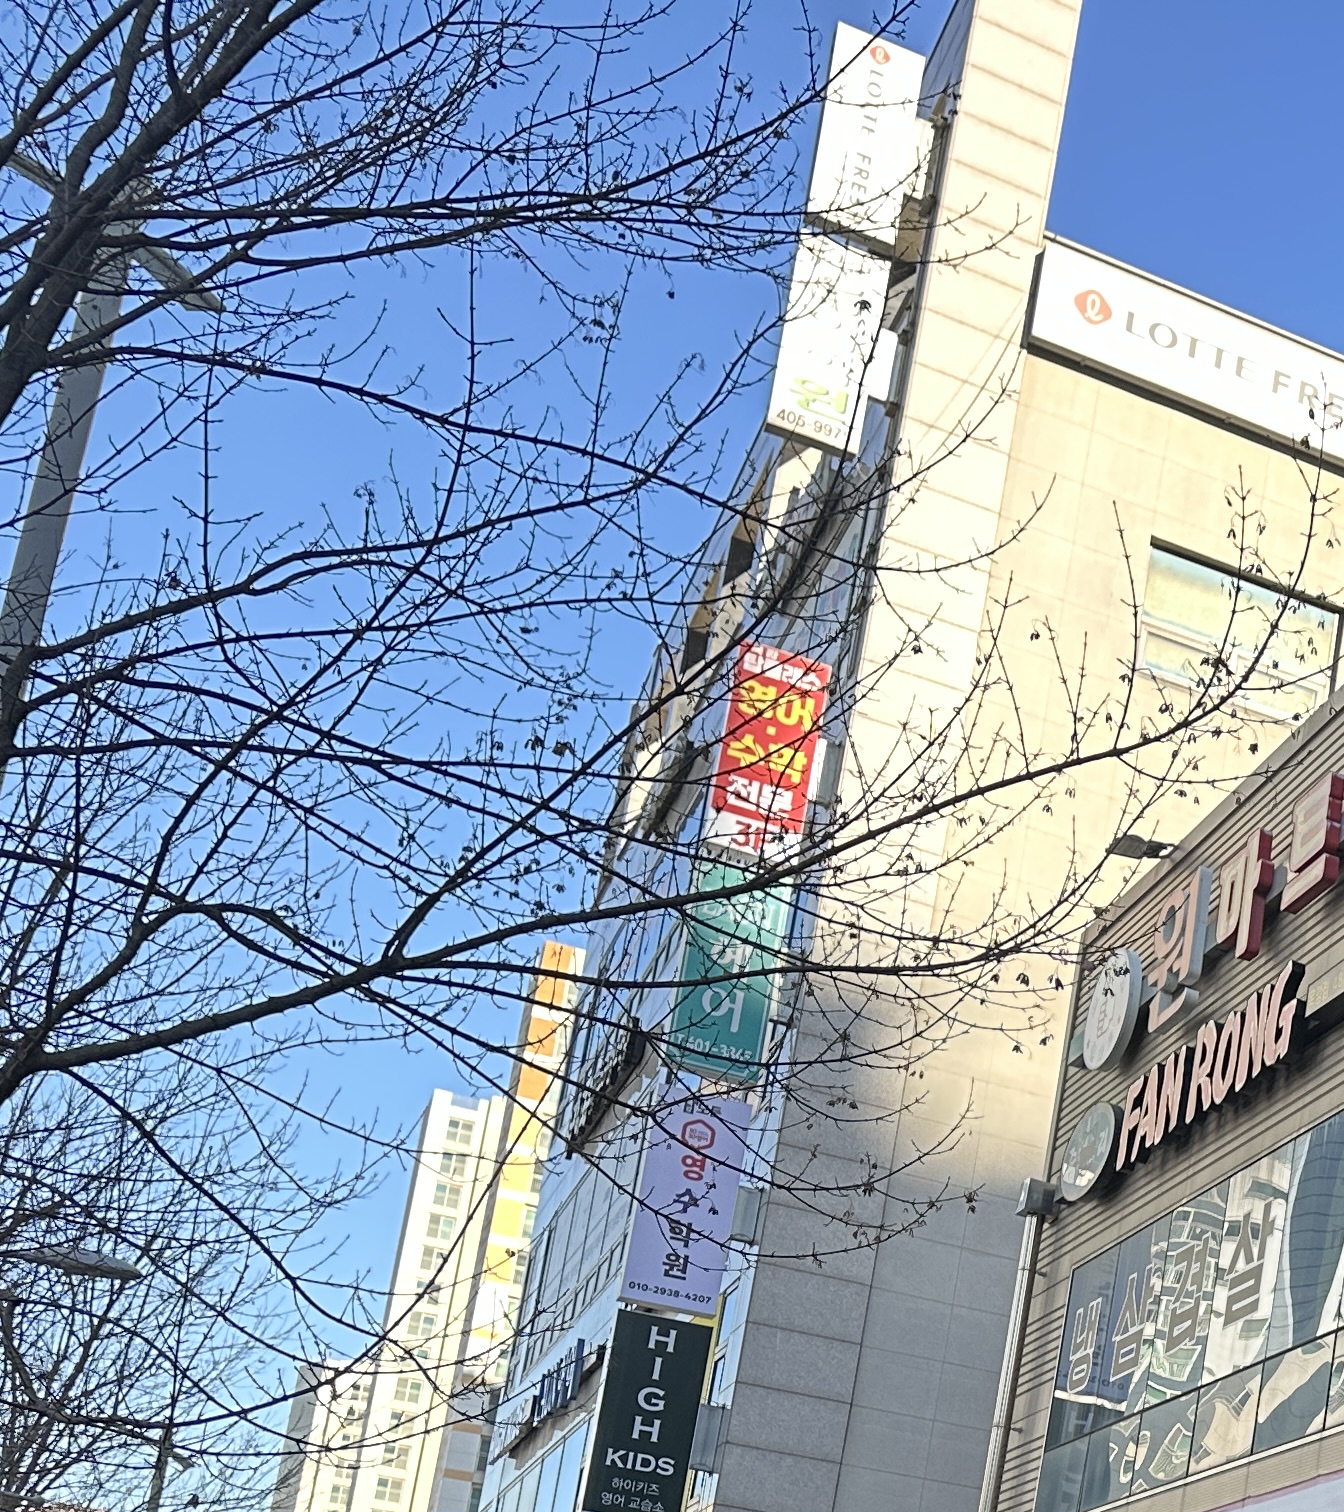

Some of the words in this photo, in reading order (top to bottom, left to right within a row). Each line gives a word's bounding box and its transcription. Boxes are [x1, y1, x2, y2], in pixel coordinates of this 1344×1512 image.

[1126, 311, 1252, 384] LOTTE
[738, 678, 816, 731] 영어
[727, 734, 808, 784] 수학
[726, 775, 794, 819] 전문
[1147, 772, 1344, 1034] 원마트
[1116, 1044, 1188, 1171] FAN
[1185, 960, 1298, 1125] RONG
[628, 1280, 712, 1305] 010-2938-4207
[631, 1325, 678, 1443] HIGH
[605, 1448, 676, 1476] KIDS
[611, 1476, 660, 1496] 하이키즈
[601, 1492, 626, 1508] 영어
